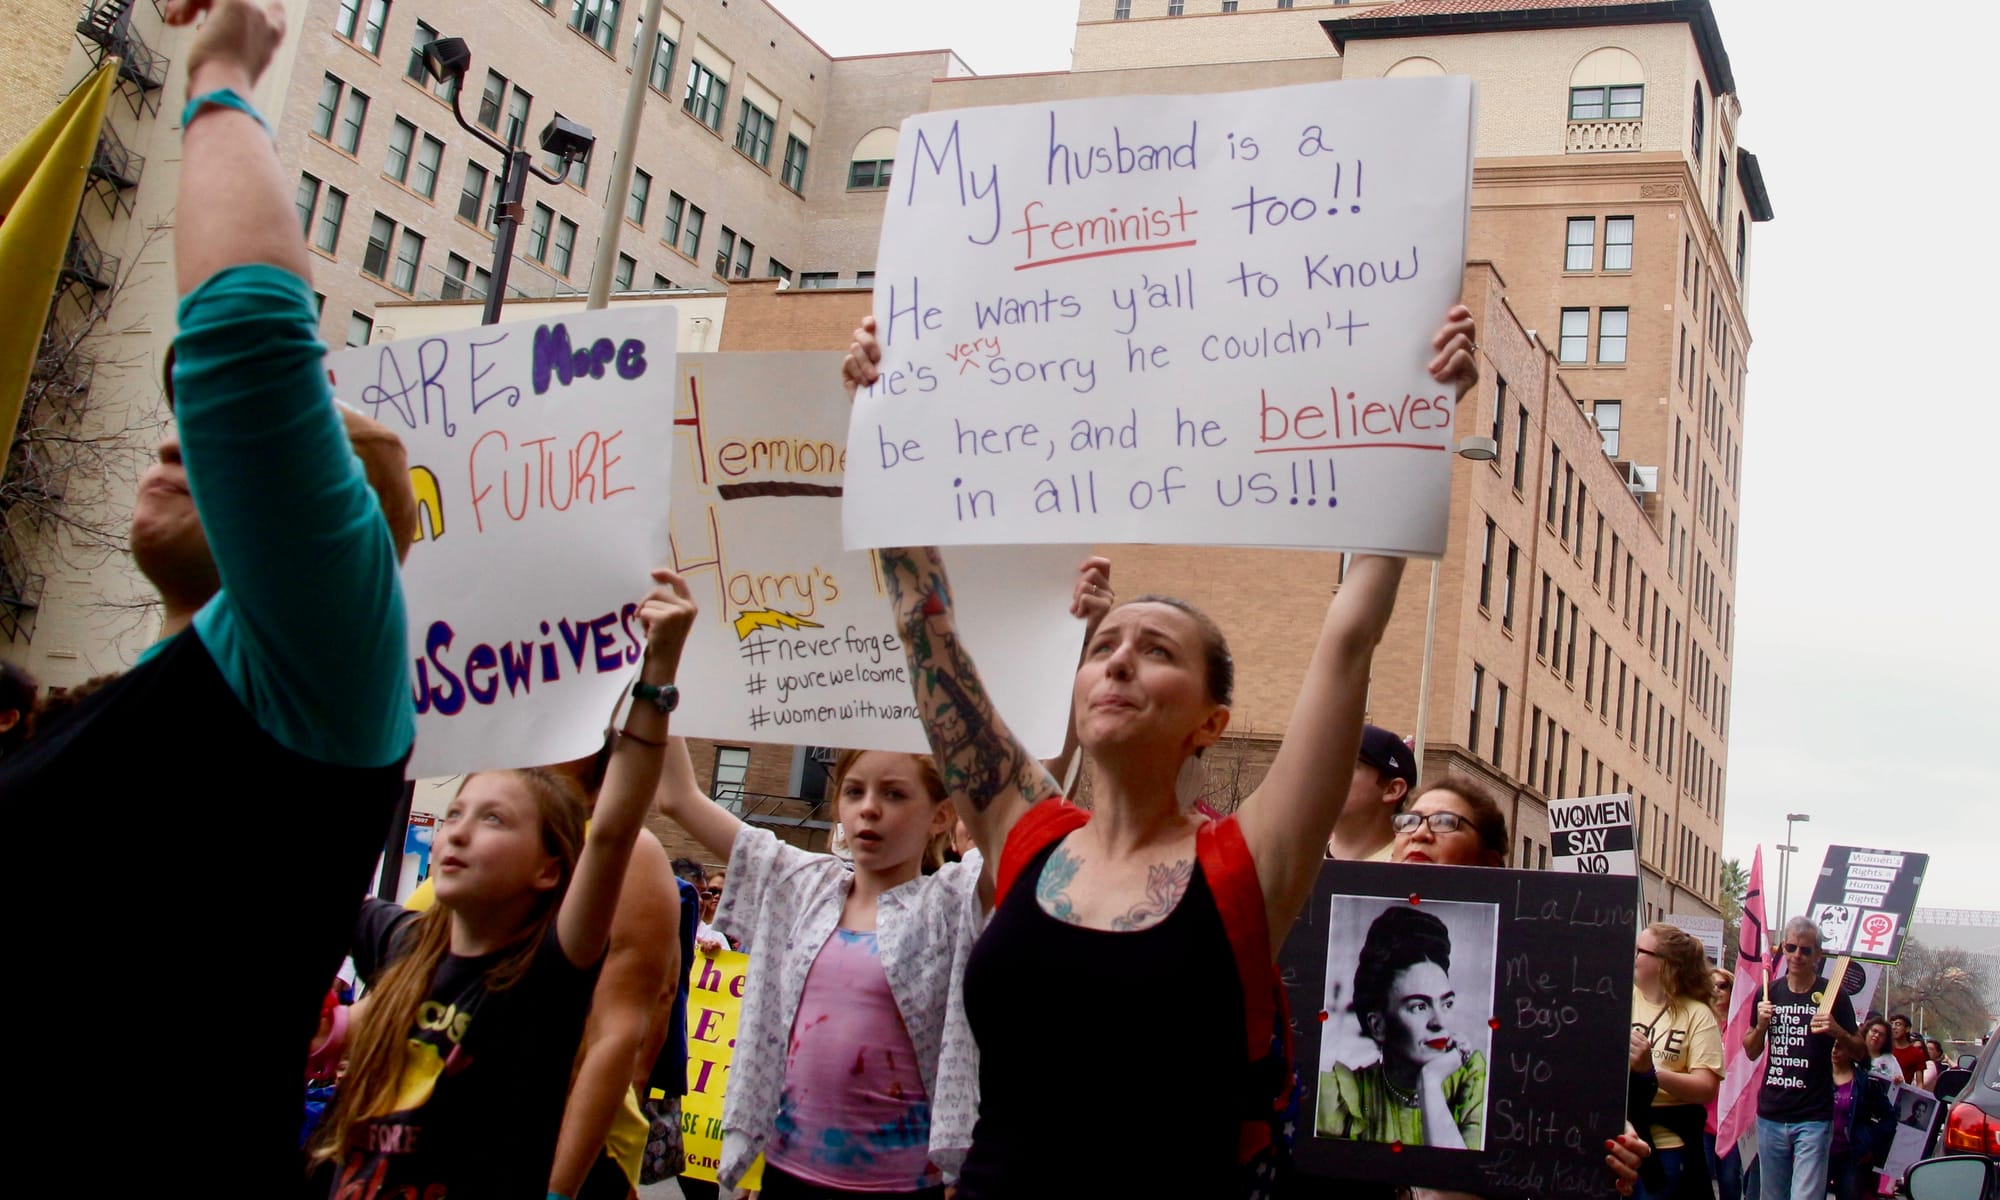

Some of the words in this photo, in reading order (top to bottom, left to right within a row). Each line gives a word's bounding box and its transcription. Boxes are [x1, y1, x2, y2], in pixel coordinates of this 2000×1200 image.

[908, 119, 1000, 245] My
[1047, 111, 1198, 186] husband
[1227, 131, 1260, 162] is
[1298, 124, 1335, 158] a
[1011, 196, 1198, 259] feminist
[1232, 160, 1364, 236] too!!
[888, 276, 942, 346] He
[974, 289, 1083, 326] wants
[1113, 267, 1195, 335] y'all
[1226, 261, 1280, 300] to
[946, 335, 1001, 362] very
[1127, 338, 1170, 372] he
[1200, 310, 1371, 362] couldn't
[362, 333, 520, 438] ARE
[879, 423, 925, 470] be
[954, 418, 1056, 462] here,
[1069, 408, 1139, 452] and
[1176, 406, 1228, 449] he
[1259, 388, 1453, 444] believes
[470, 430, 636, 534] FUTURE
[952, 477, 996, 522] in
[1034, 470, 1098, 515] all
[1128, 465, 1187, 511] of
[1216, 458, 1338, 510] us!!!
[669, 505, 840, 624] Harry's
[1550, 800, 1630, 829] WOMEN
[1568, 829, 1608, 855] SAY
[1577, 854, 1610, 874] NO
[1852, 854, 1901, 866] Women's
[1848, 880, 1887, 891] Human
[1851, 866, 1882, 877] Rights
[1514, 879, 1561, 921] La
[1569, 889, 1635, 928] Luna
[1847, 893, 1880, 904] Rights
[1571, 955, 1619, 1001] La
[1515, 996, 1580, 1041] Bajo
[1771, 1024, 1808, 1035] adical
[1772, 1003, 1818, 1015] Feminis
[1780, 1014, 1800, 1025] the
[1771, 1045, 1789, 1056] hat
